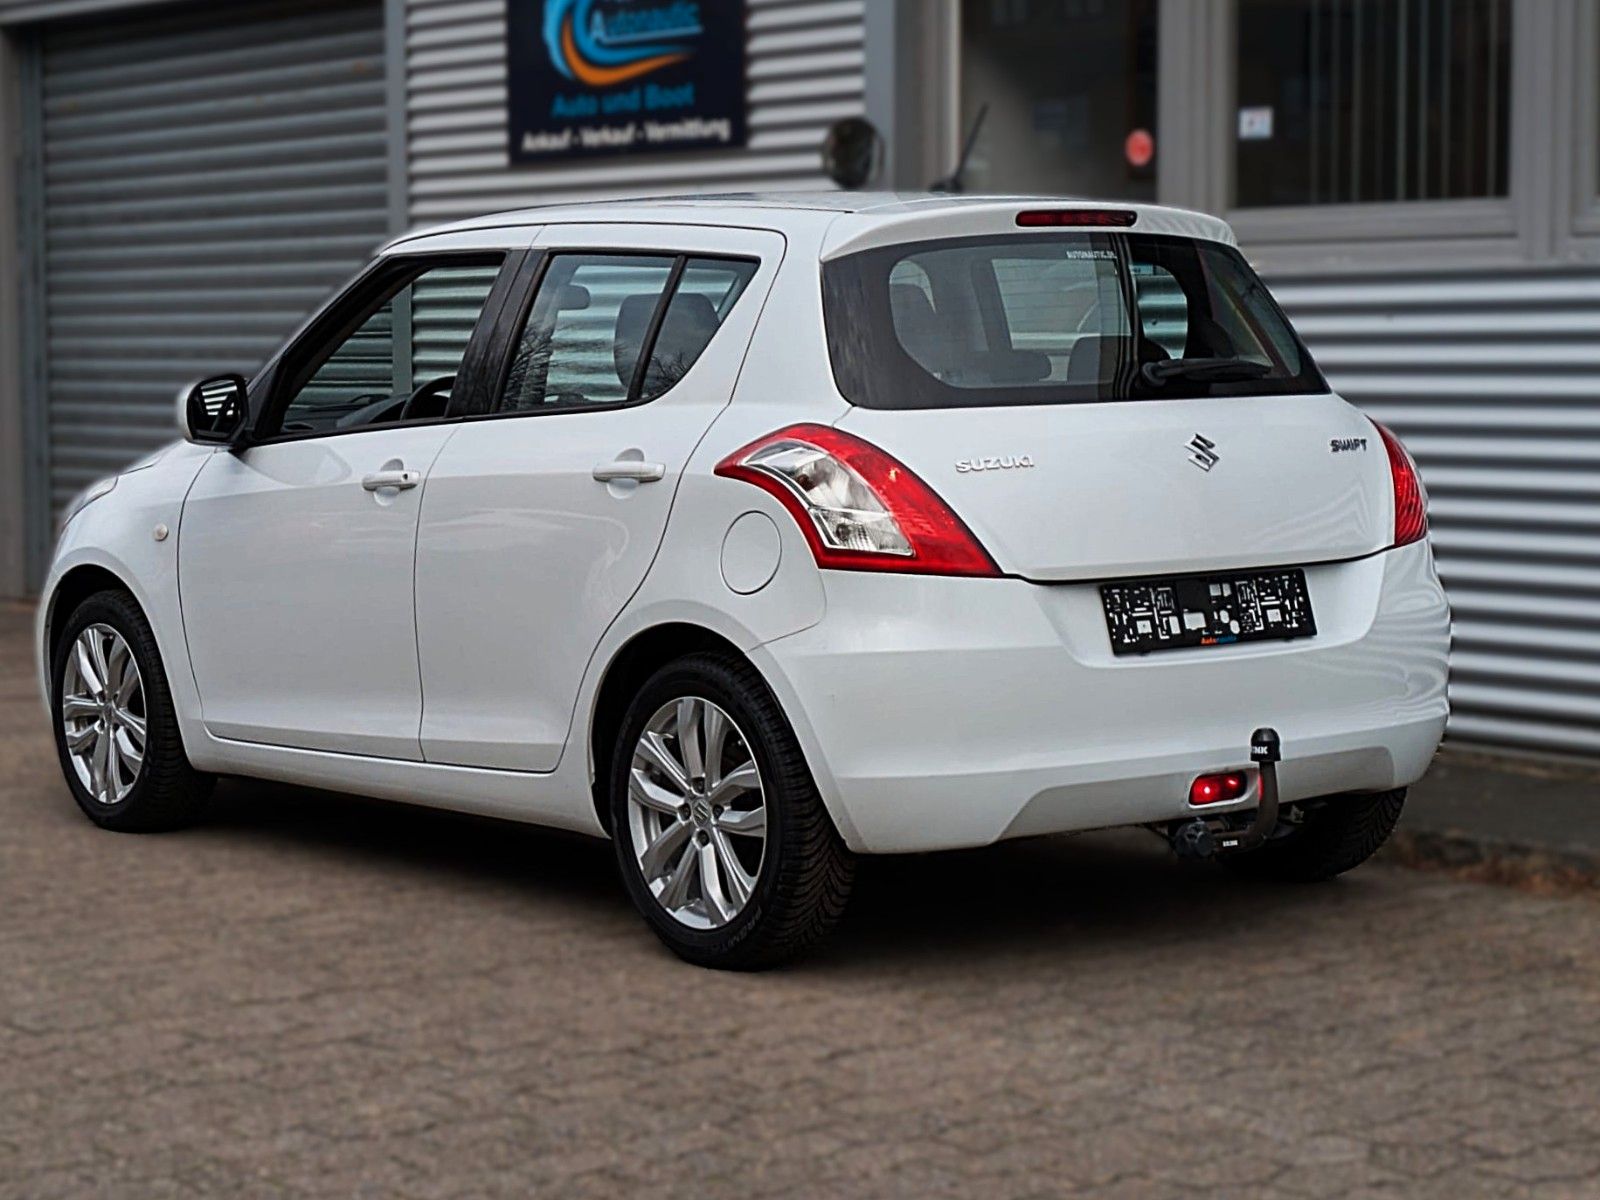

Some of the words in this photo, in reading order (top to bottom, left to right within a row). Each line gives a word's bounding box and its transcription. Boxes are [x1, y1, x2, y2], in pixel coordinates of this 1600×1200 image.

[522, 127, 572, 151] Ankauf
[580, 123, 636, 147] Verkauf
[644, 117, 730, 143] Vermittlung
[1330, 438, 1367, 453] SWIFT
[954, 454, 1035, 473] SUZUKI
